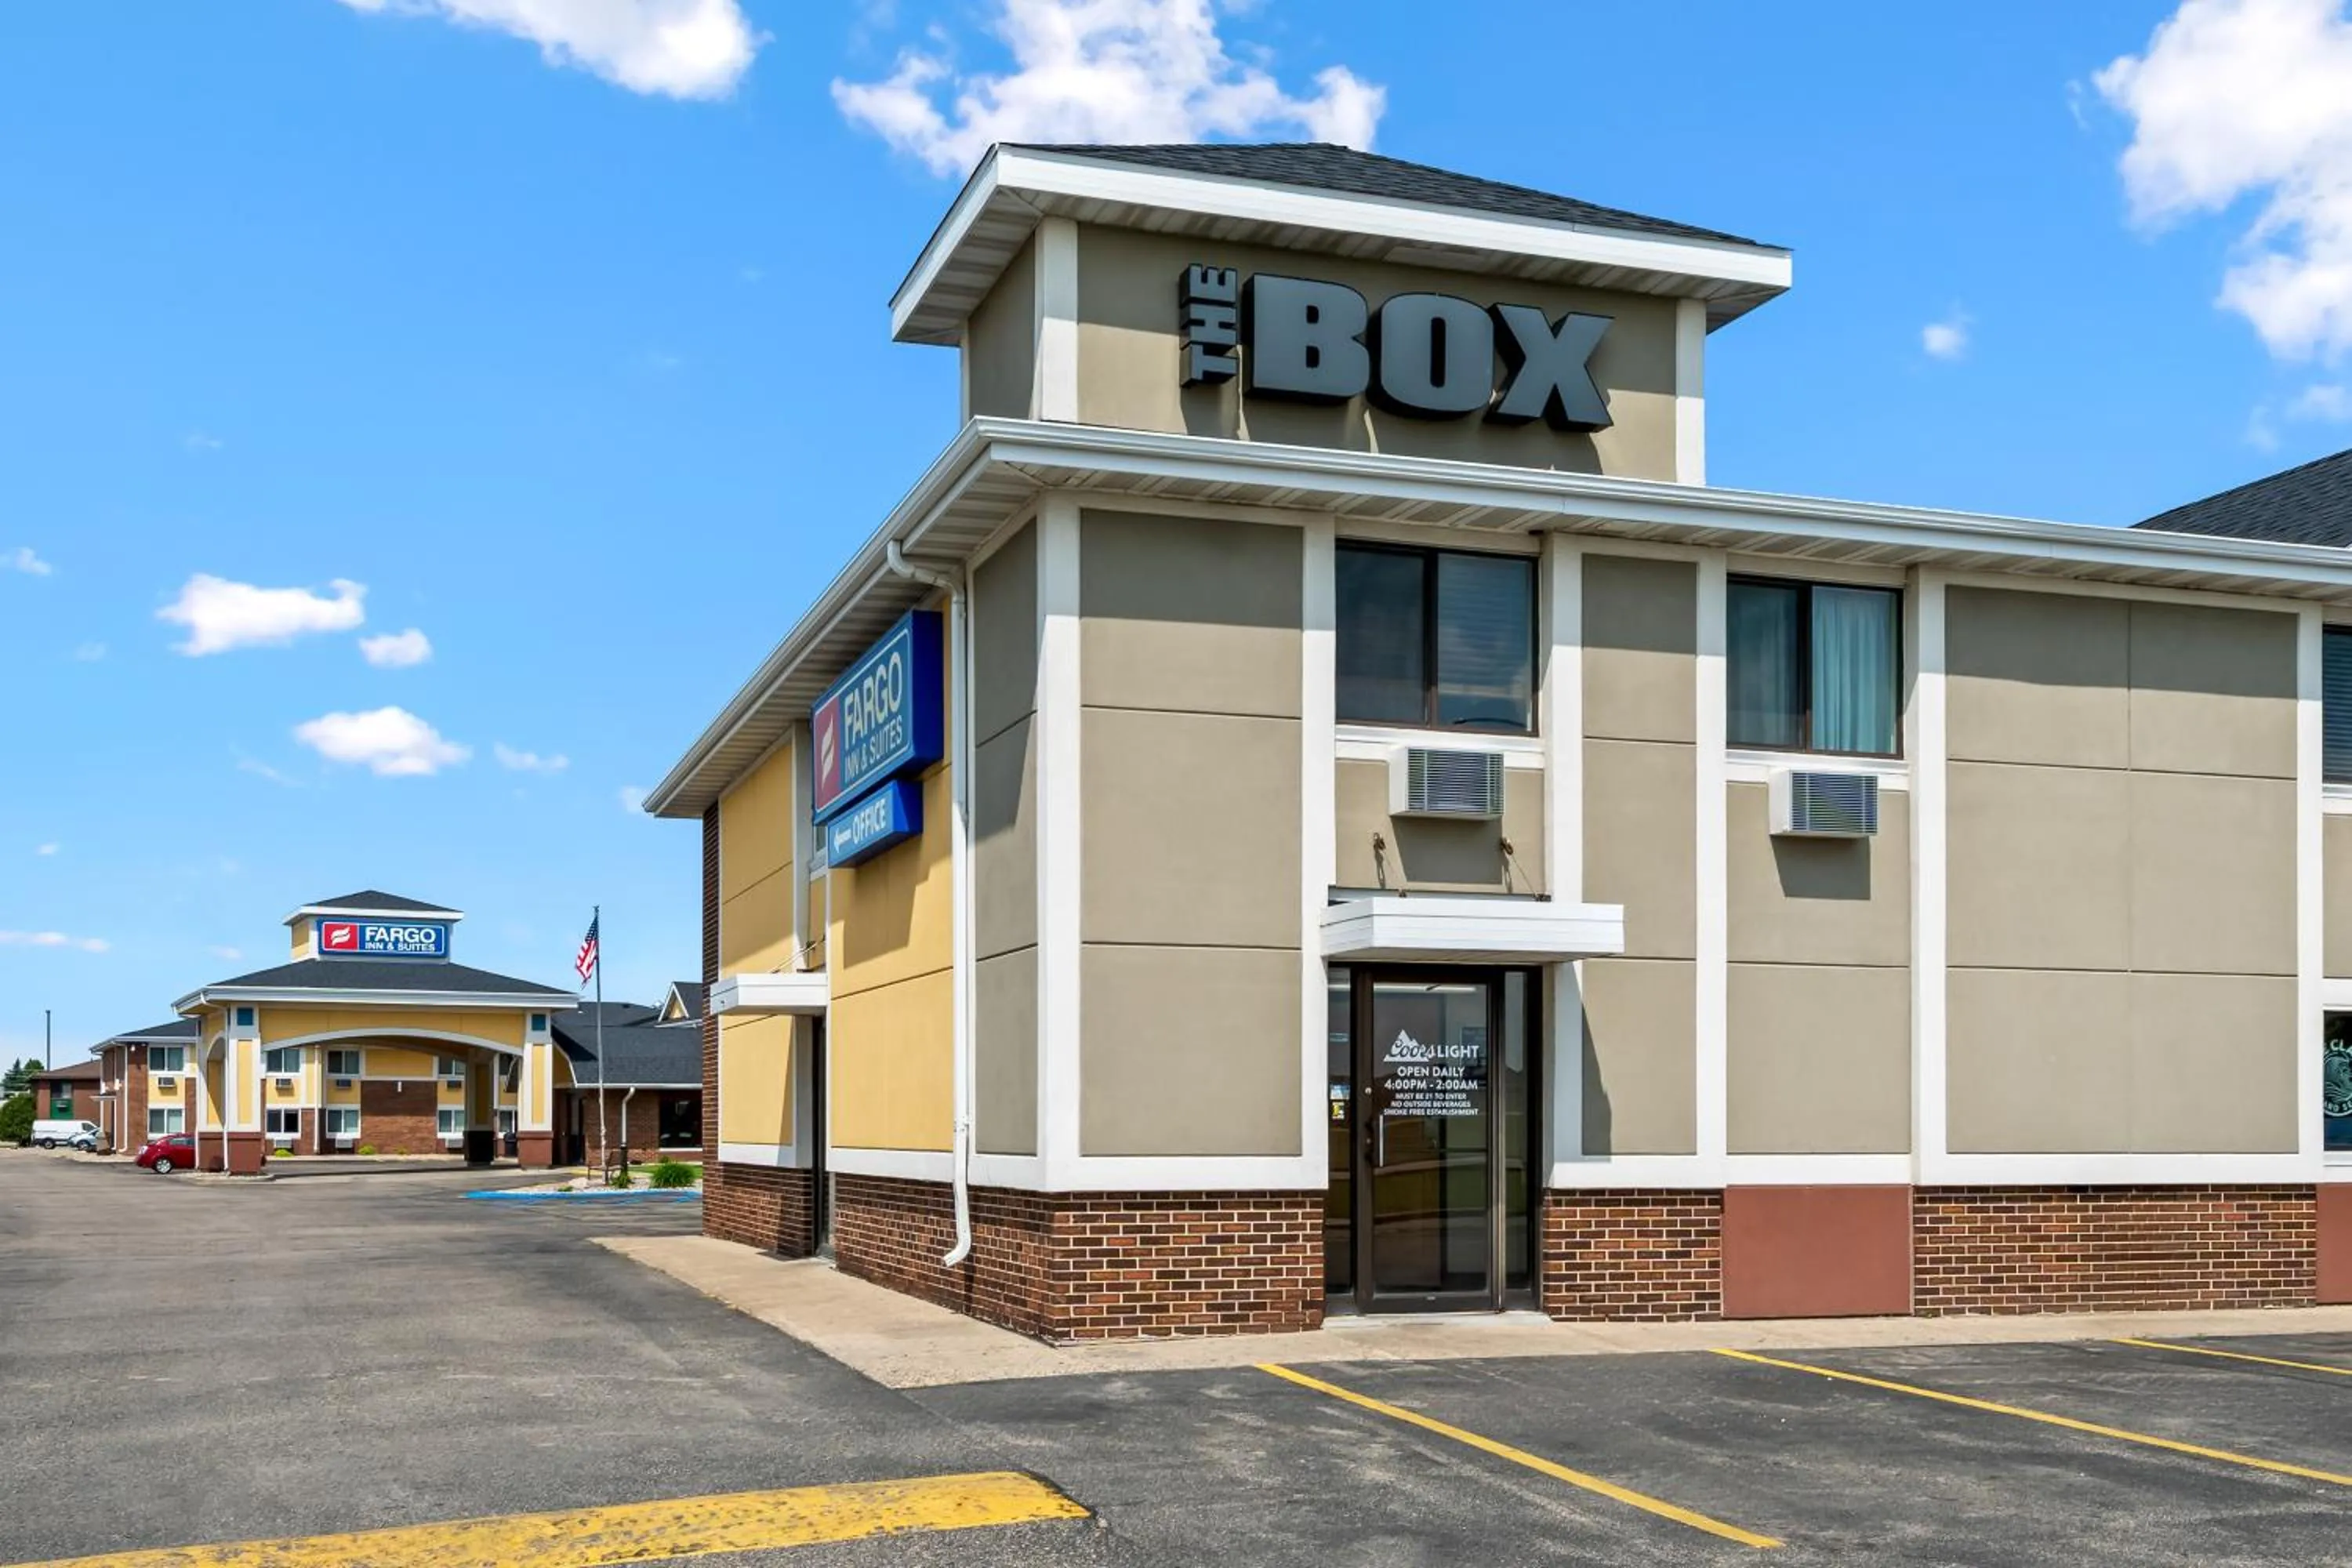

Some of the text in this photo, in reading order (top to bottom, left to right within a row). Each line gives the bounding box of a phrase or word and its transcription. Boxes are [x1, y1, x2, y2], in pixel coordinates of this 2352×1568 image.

[1182, 263, 1239, 387] THE
[1248, 272, 1616, 430] BOX
[844, 651, 902, 750] FARGO
[844, 714, 902, 784] INN & SUITES
[852, 797, 887, 844] OFFICE
[365, 926, 437, 943] FARGO
[397, 942, 436, 952] SUITES
[1390, 1038, 1480, 1059] Coors LIGHT
[1384, 1078, 1428, 1091] 4:00PM
[1436, 1079, 1479, 1091] 2:00AM
[1396, 1065, 1465, 1077] OPEN DAILY
